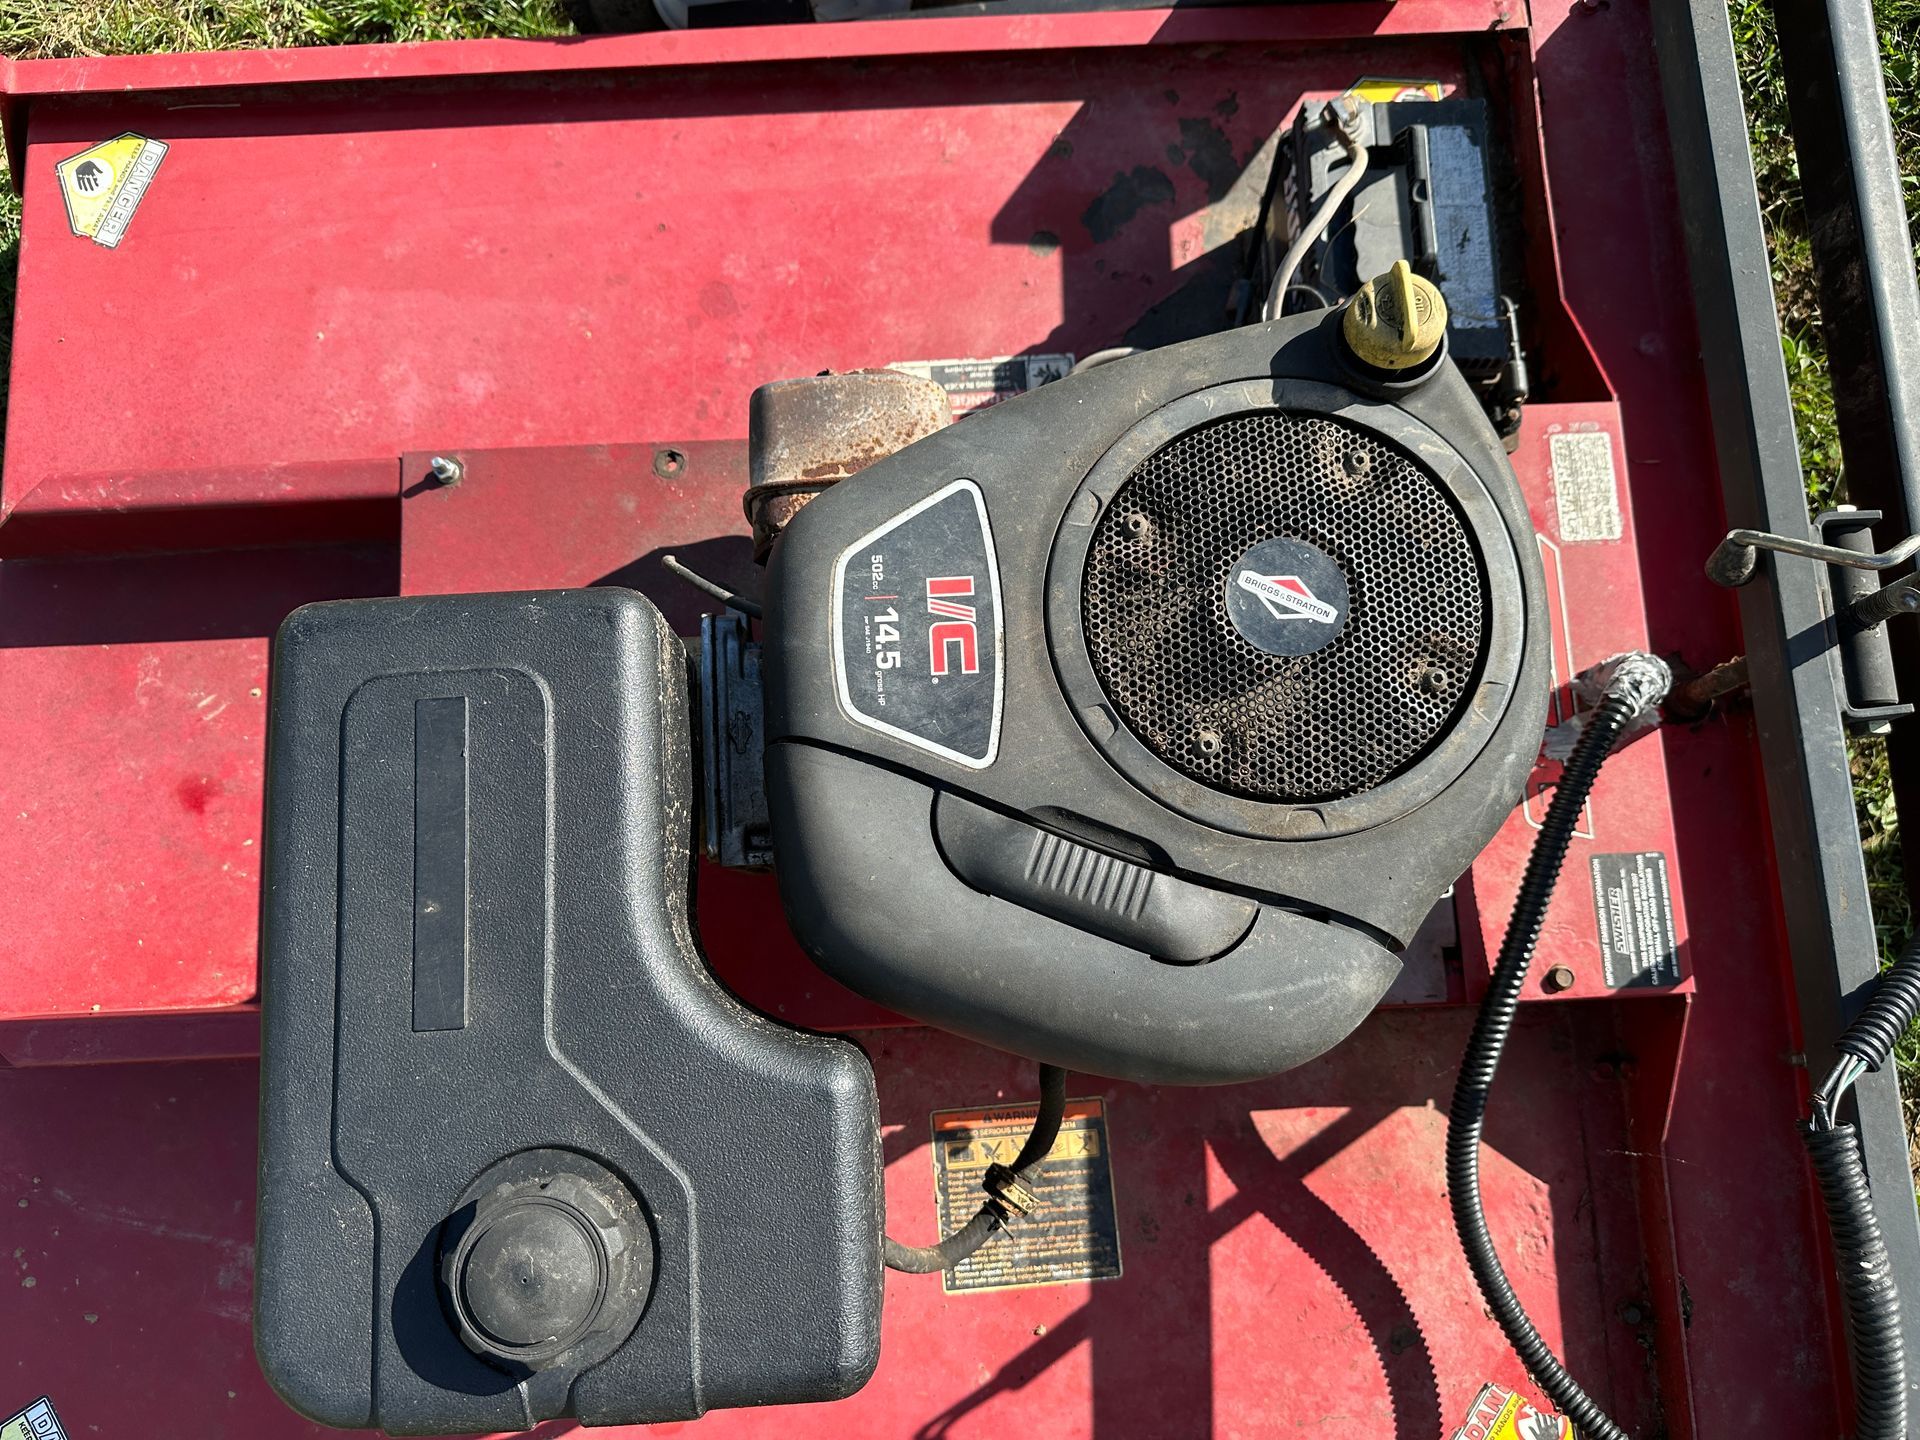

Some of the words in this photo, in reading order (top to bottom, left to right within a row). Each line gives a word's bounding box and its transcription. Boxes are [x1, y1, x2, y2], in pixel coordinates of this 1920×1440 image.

[102, 149, 158, 235] DANGER
[948, 391, 1000, 406] DANGE
[874, 605, 900, 669] 14.5
[874, 670, 883, 692] gross
[876, 693, 885, 705] HP
[1608, 888, 1625, 952] SWISHER
[1602, 943, 1615, 985] IMPORTANT
[1494, 1408, 1513, 1436] HANDS
